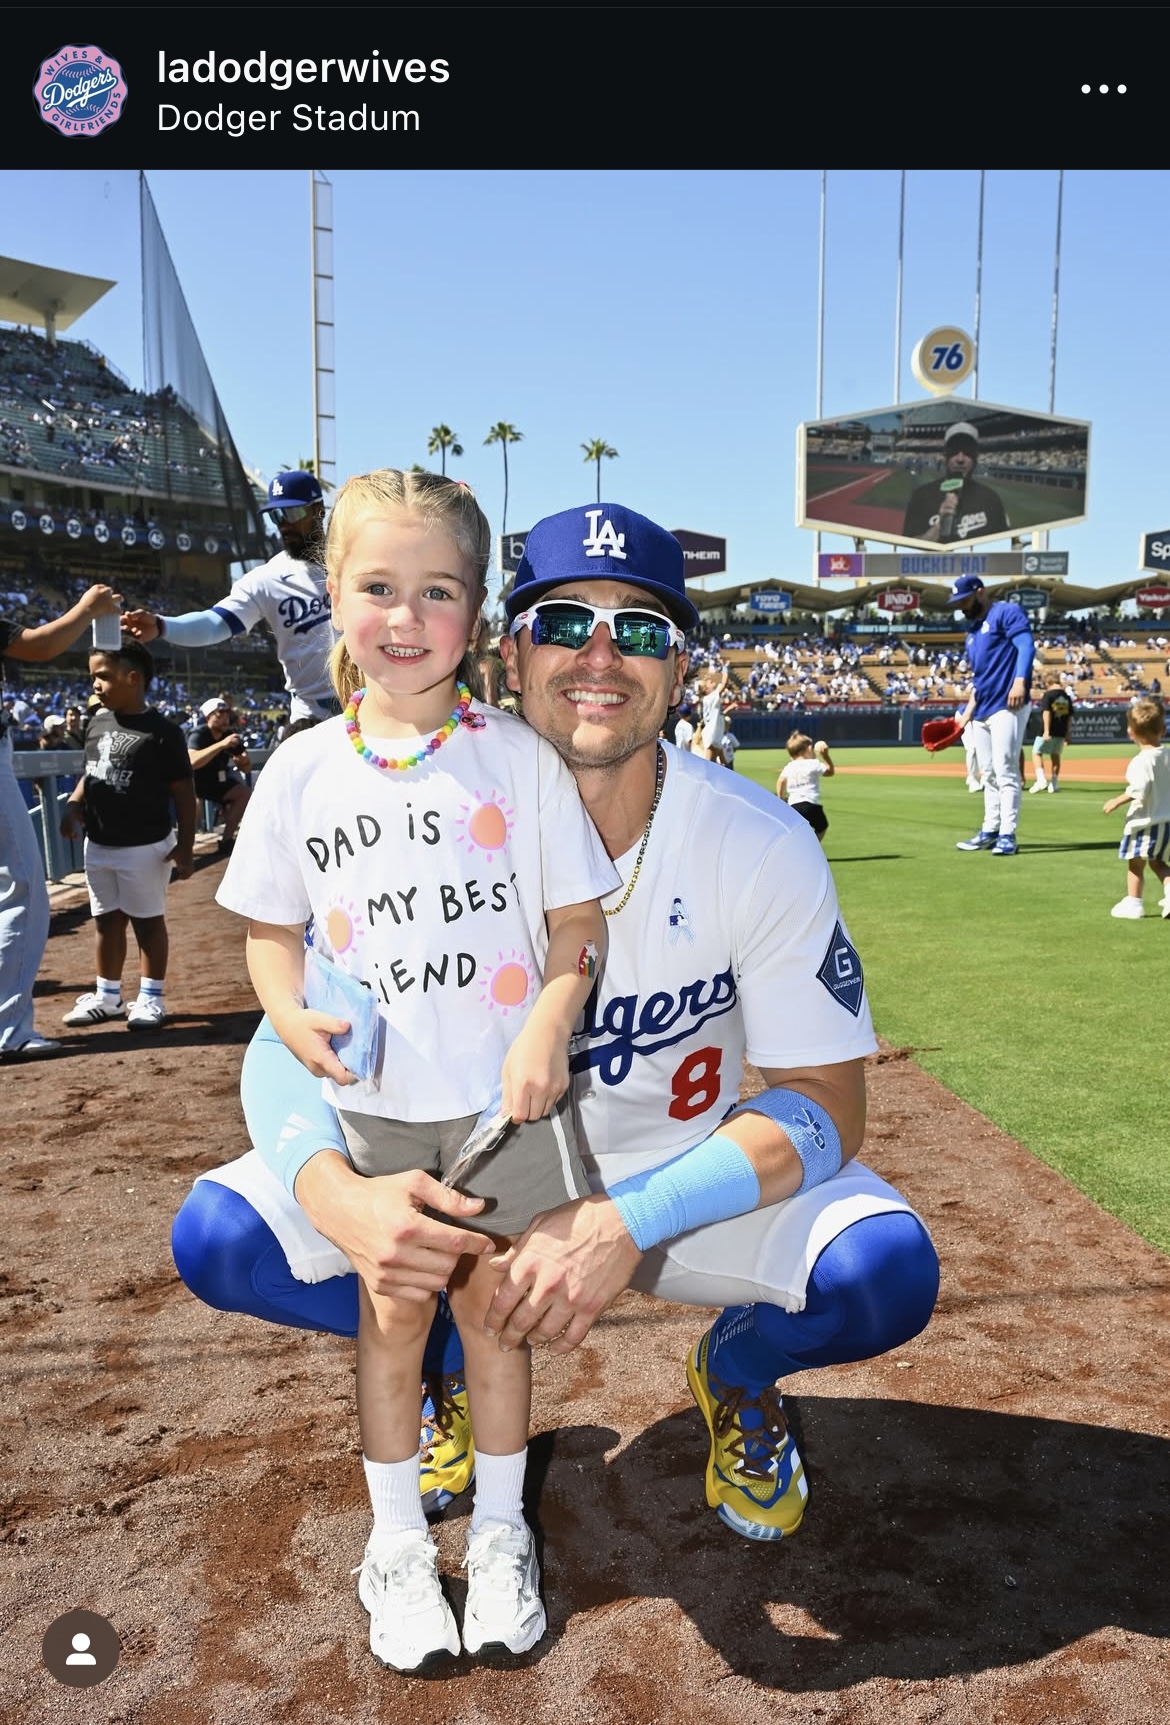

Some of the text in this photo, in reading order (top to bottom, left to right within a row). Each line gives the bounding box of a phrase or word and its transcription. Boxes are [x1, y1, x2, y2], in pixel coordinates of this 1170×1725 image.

[932, 343, 964, 371] 76
[582, 509, 627, 560] LA
[683, 550, 720, 560] NHEIM
[901, 555, 987, 574] BUCKET HAT
[755, 594, 780, 602] TOYO
[884, 593, 913, 607] JINRO
[110, 732, 141, 755] 37
[306, 814, 382, 873] DAD
[367, 886, 418, 927] MY
[834, 946, 853, 979] G
[359, 952, 477, 1005] iEND
[668, 1046, 723, 1122] 8
